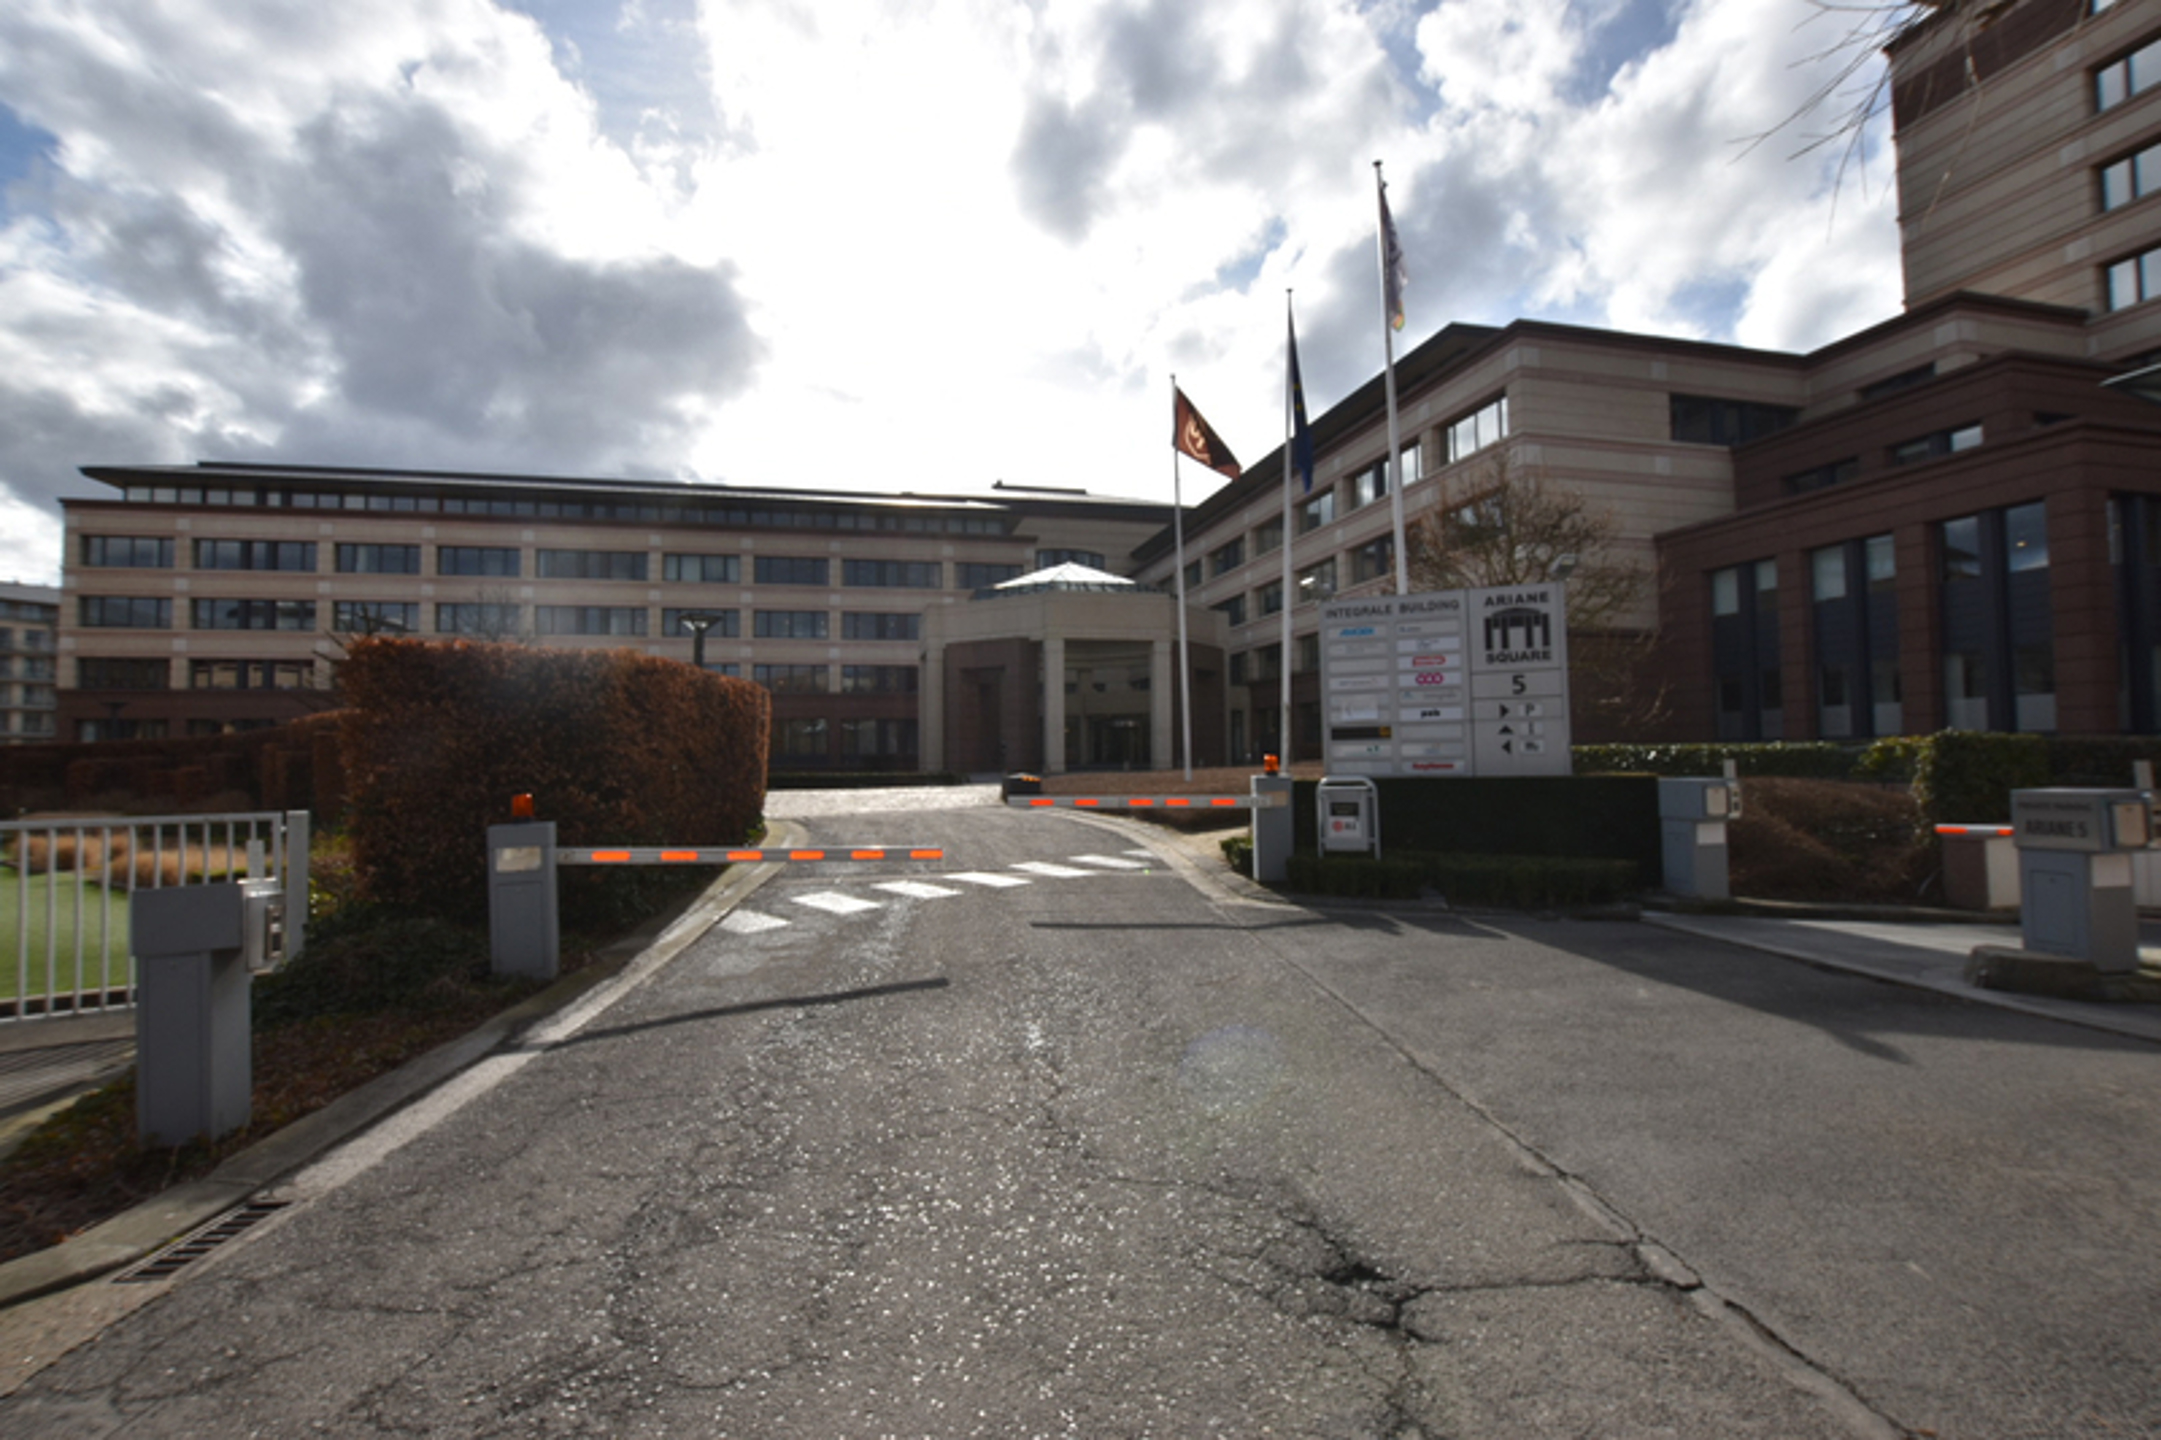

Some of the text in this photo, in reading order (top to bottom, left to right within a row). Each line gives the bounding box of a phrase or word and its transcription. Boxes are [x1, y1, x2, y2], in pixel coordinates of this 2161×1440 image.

[1484, 591, 1549, 607] ARIANE
[1325, 599, 1460, 619] INTEGRALE BUILDING
[1486, 650, 1552, 665] SQUARE
[1512, 674, 1527, 695] 5
[1525, 702, 1536, 717] P
